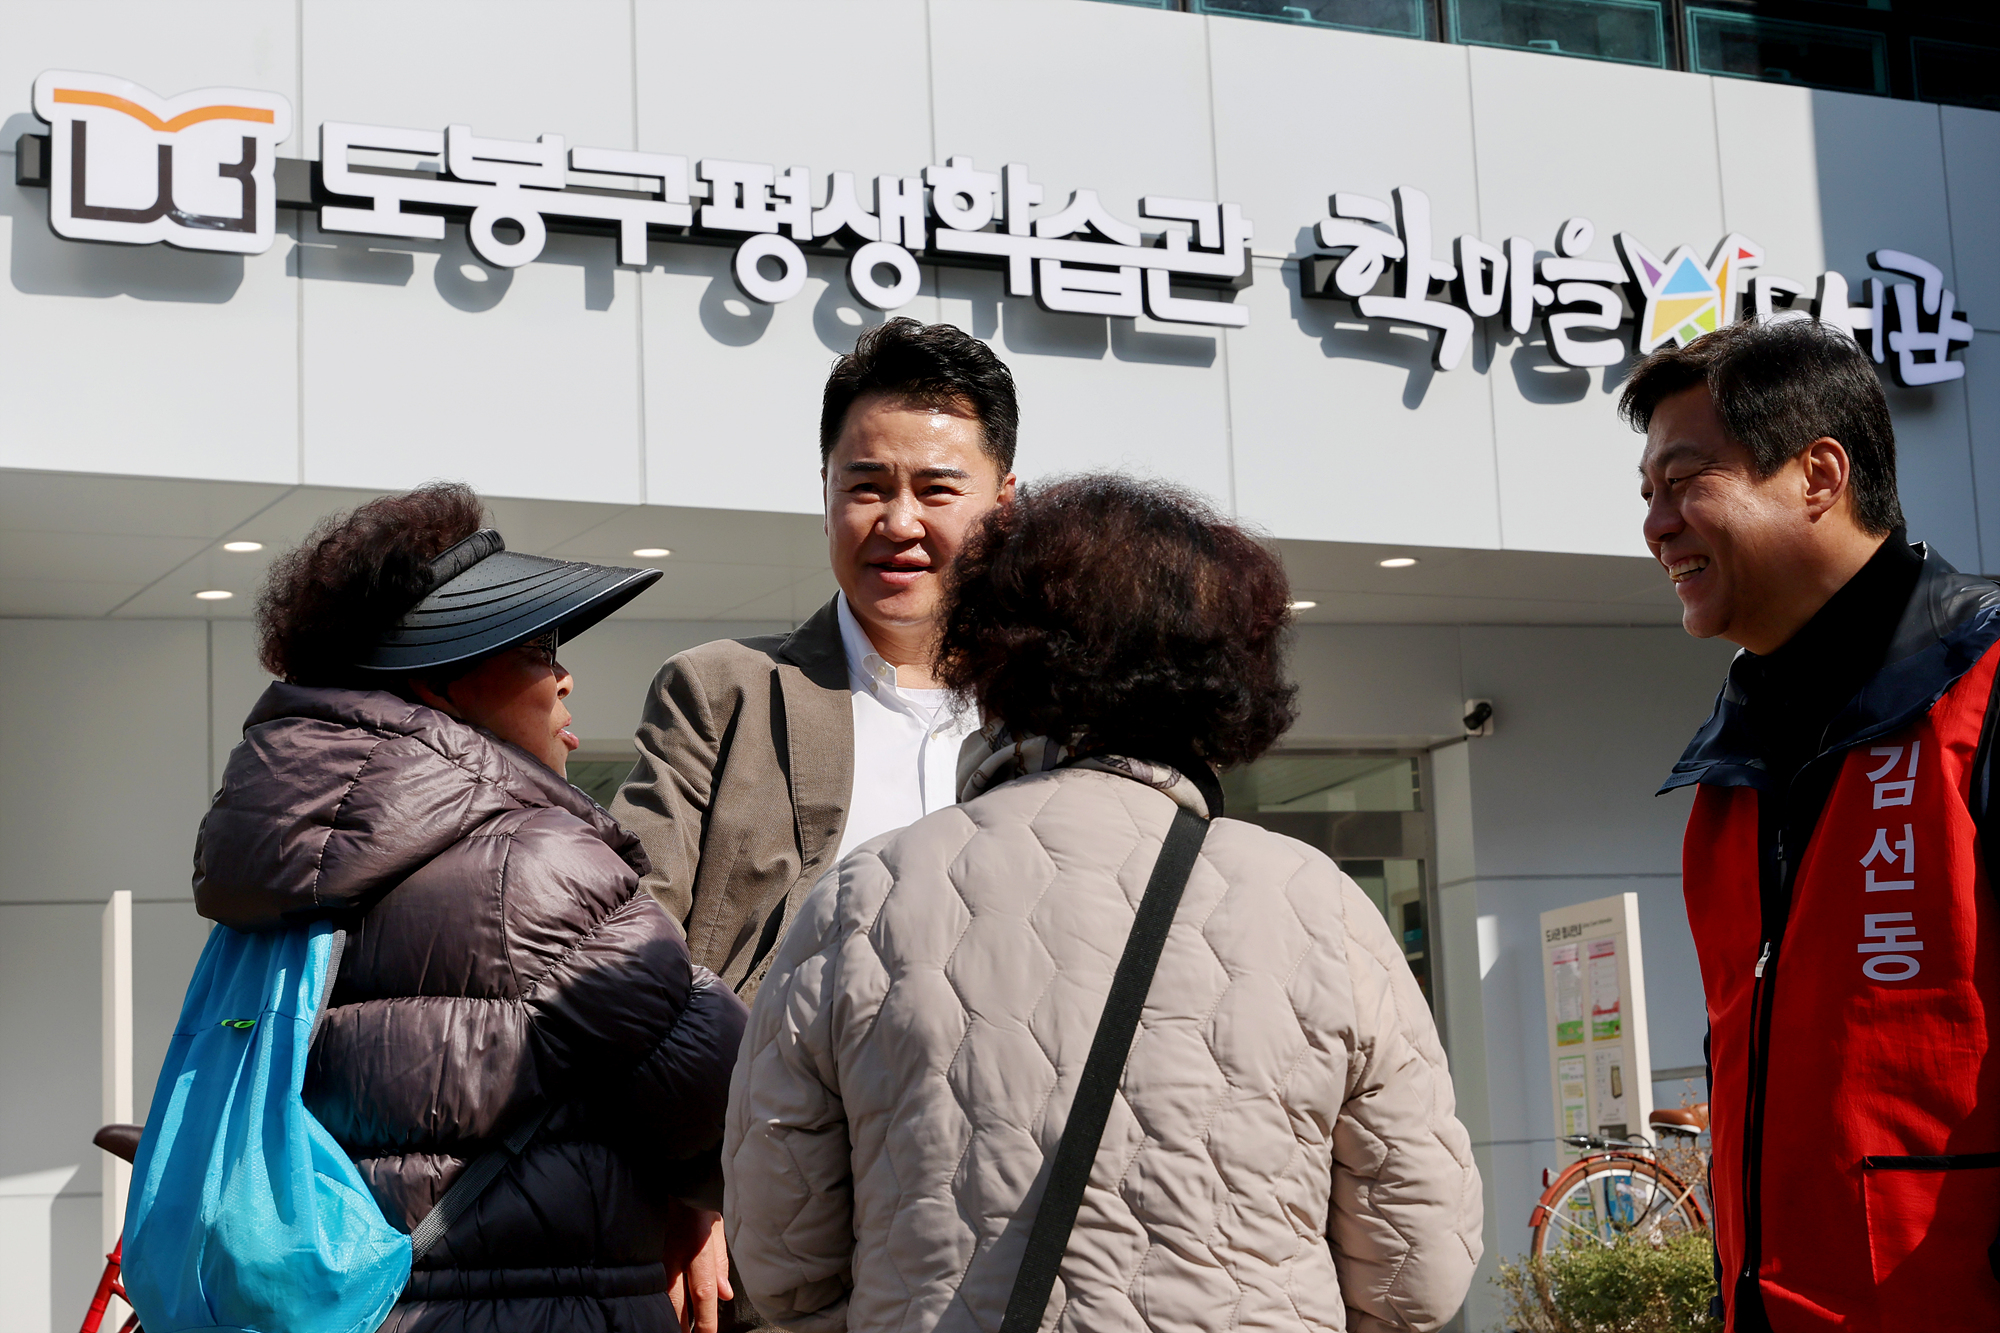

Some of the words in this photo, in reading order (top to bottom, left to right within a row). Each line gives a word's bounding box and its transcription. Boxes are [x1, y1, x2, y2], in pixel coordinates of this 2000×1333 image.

[319, 121, 1254, 328] 도봉구평생학습관
[1314, 186, 1626, 371] 학마을
[1857, 740, 1924, 982] 김선동
